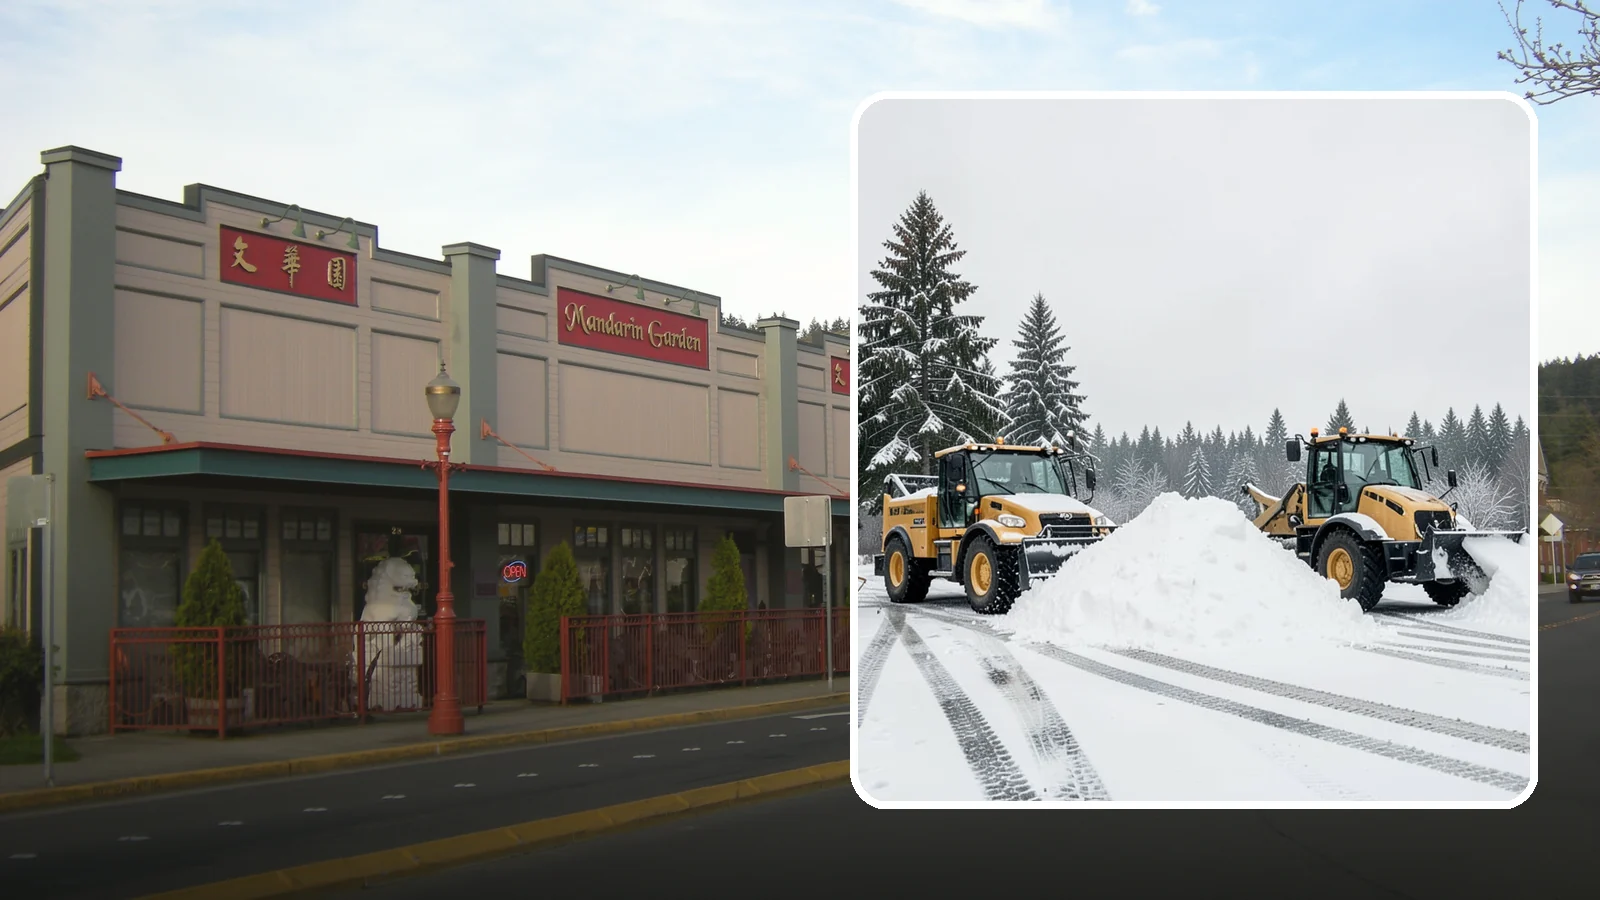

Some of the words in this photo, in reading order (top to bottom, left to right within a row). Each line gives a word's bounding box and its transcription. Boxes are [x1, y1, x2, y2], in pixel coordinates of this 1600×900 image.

[231, 235, 346, 290] 文華園
[564, 302, 644, 341] Mandarin
[648, 320, 701, 352] Garden
[503, 565, 527, 578] OPEN
